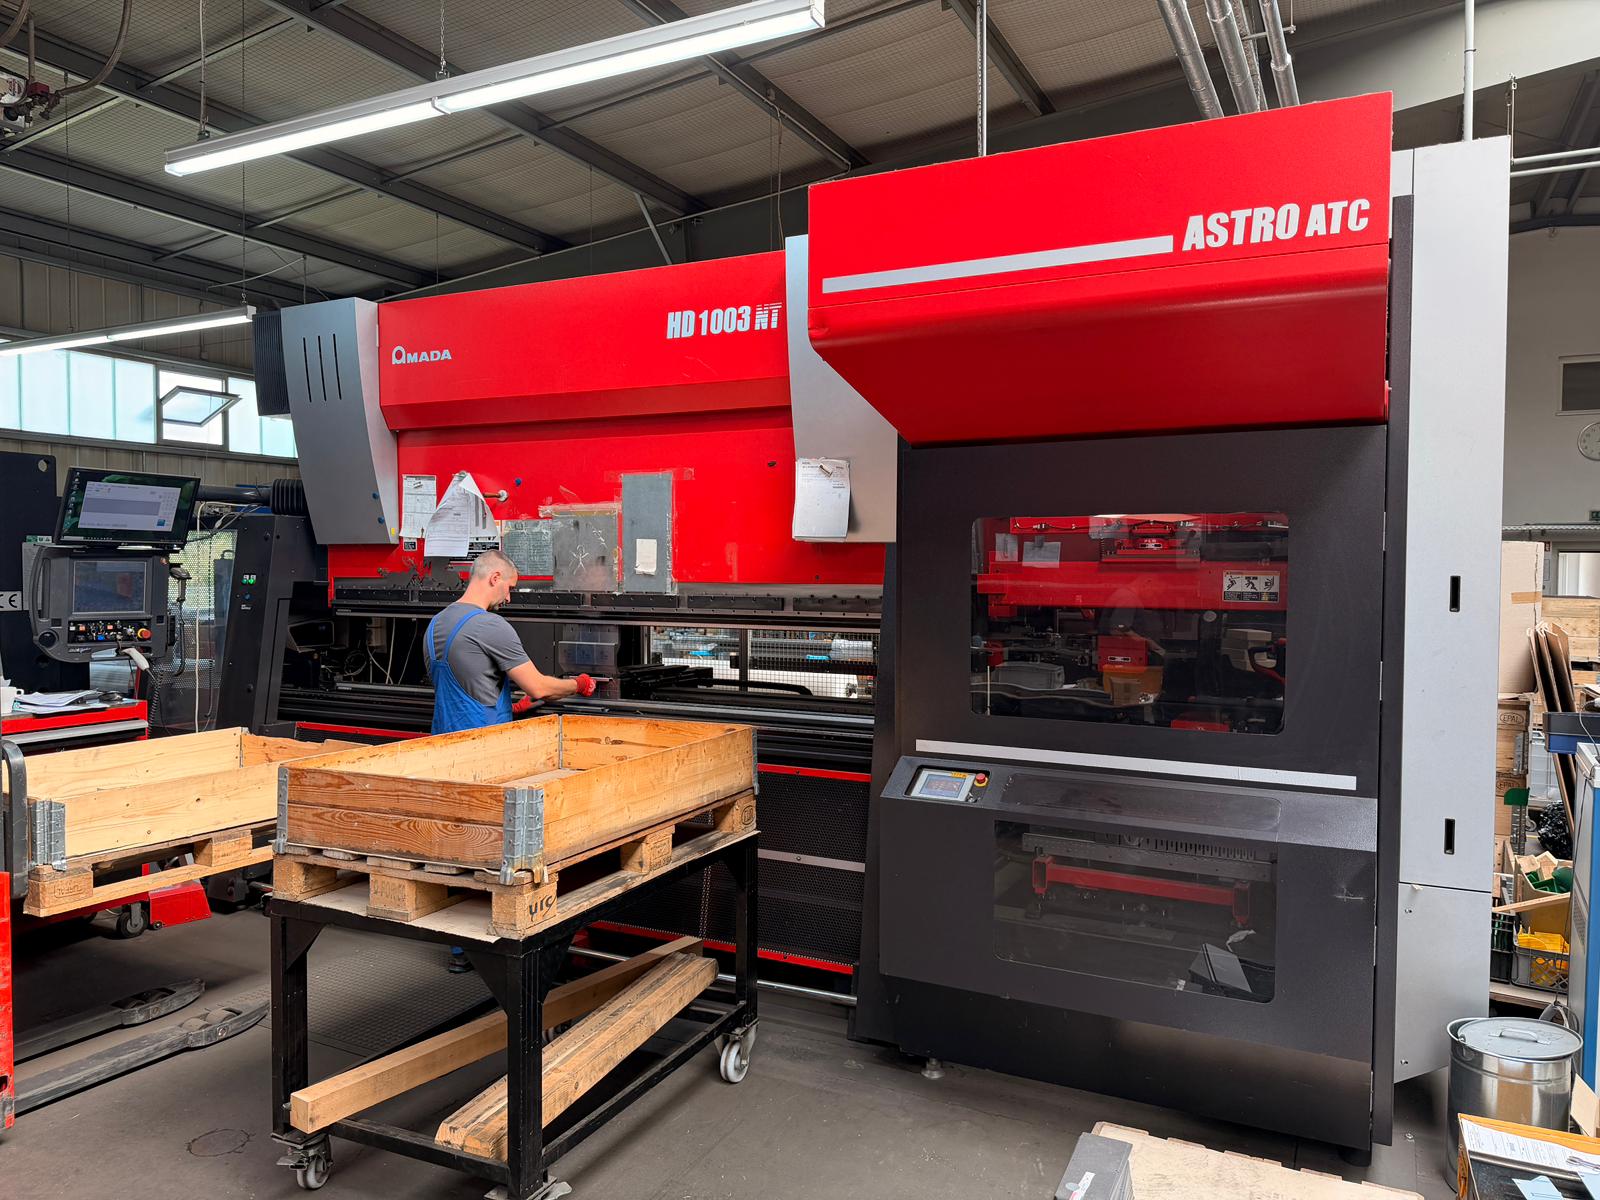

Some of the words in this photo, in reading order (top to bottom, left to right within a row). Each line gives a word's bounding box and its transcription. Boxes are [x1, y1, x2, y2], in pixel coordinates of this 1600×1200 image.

[1182, 203, 1300, 252] ASTRO
[1305, 198, 1371, 237] ATC
[666, 310, 696, 339] HD
[698, 305, 751, 336] 1003
[754, 302, 783, 331] NT
[391, 345, 453, 365] AMADA
